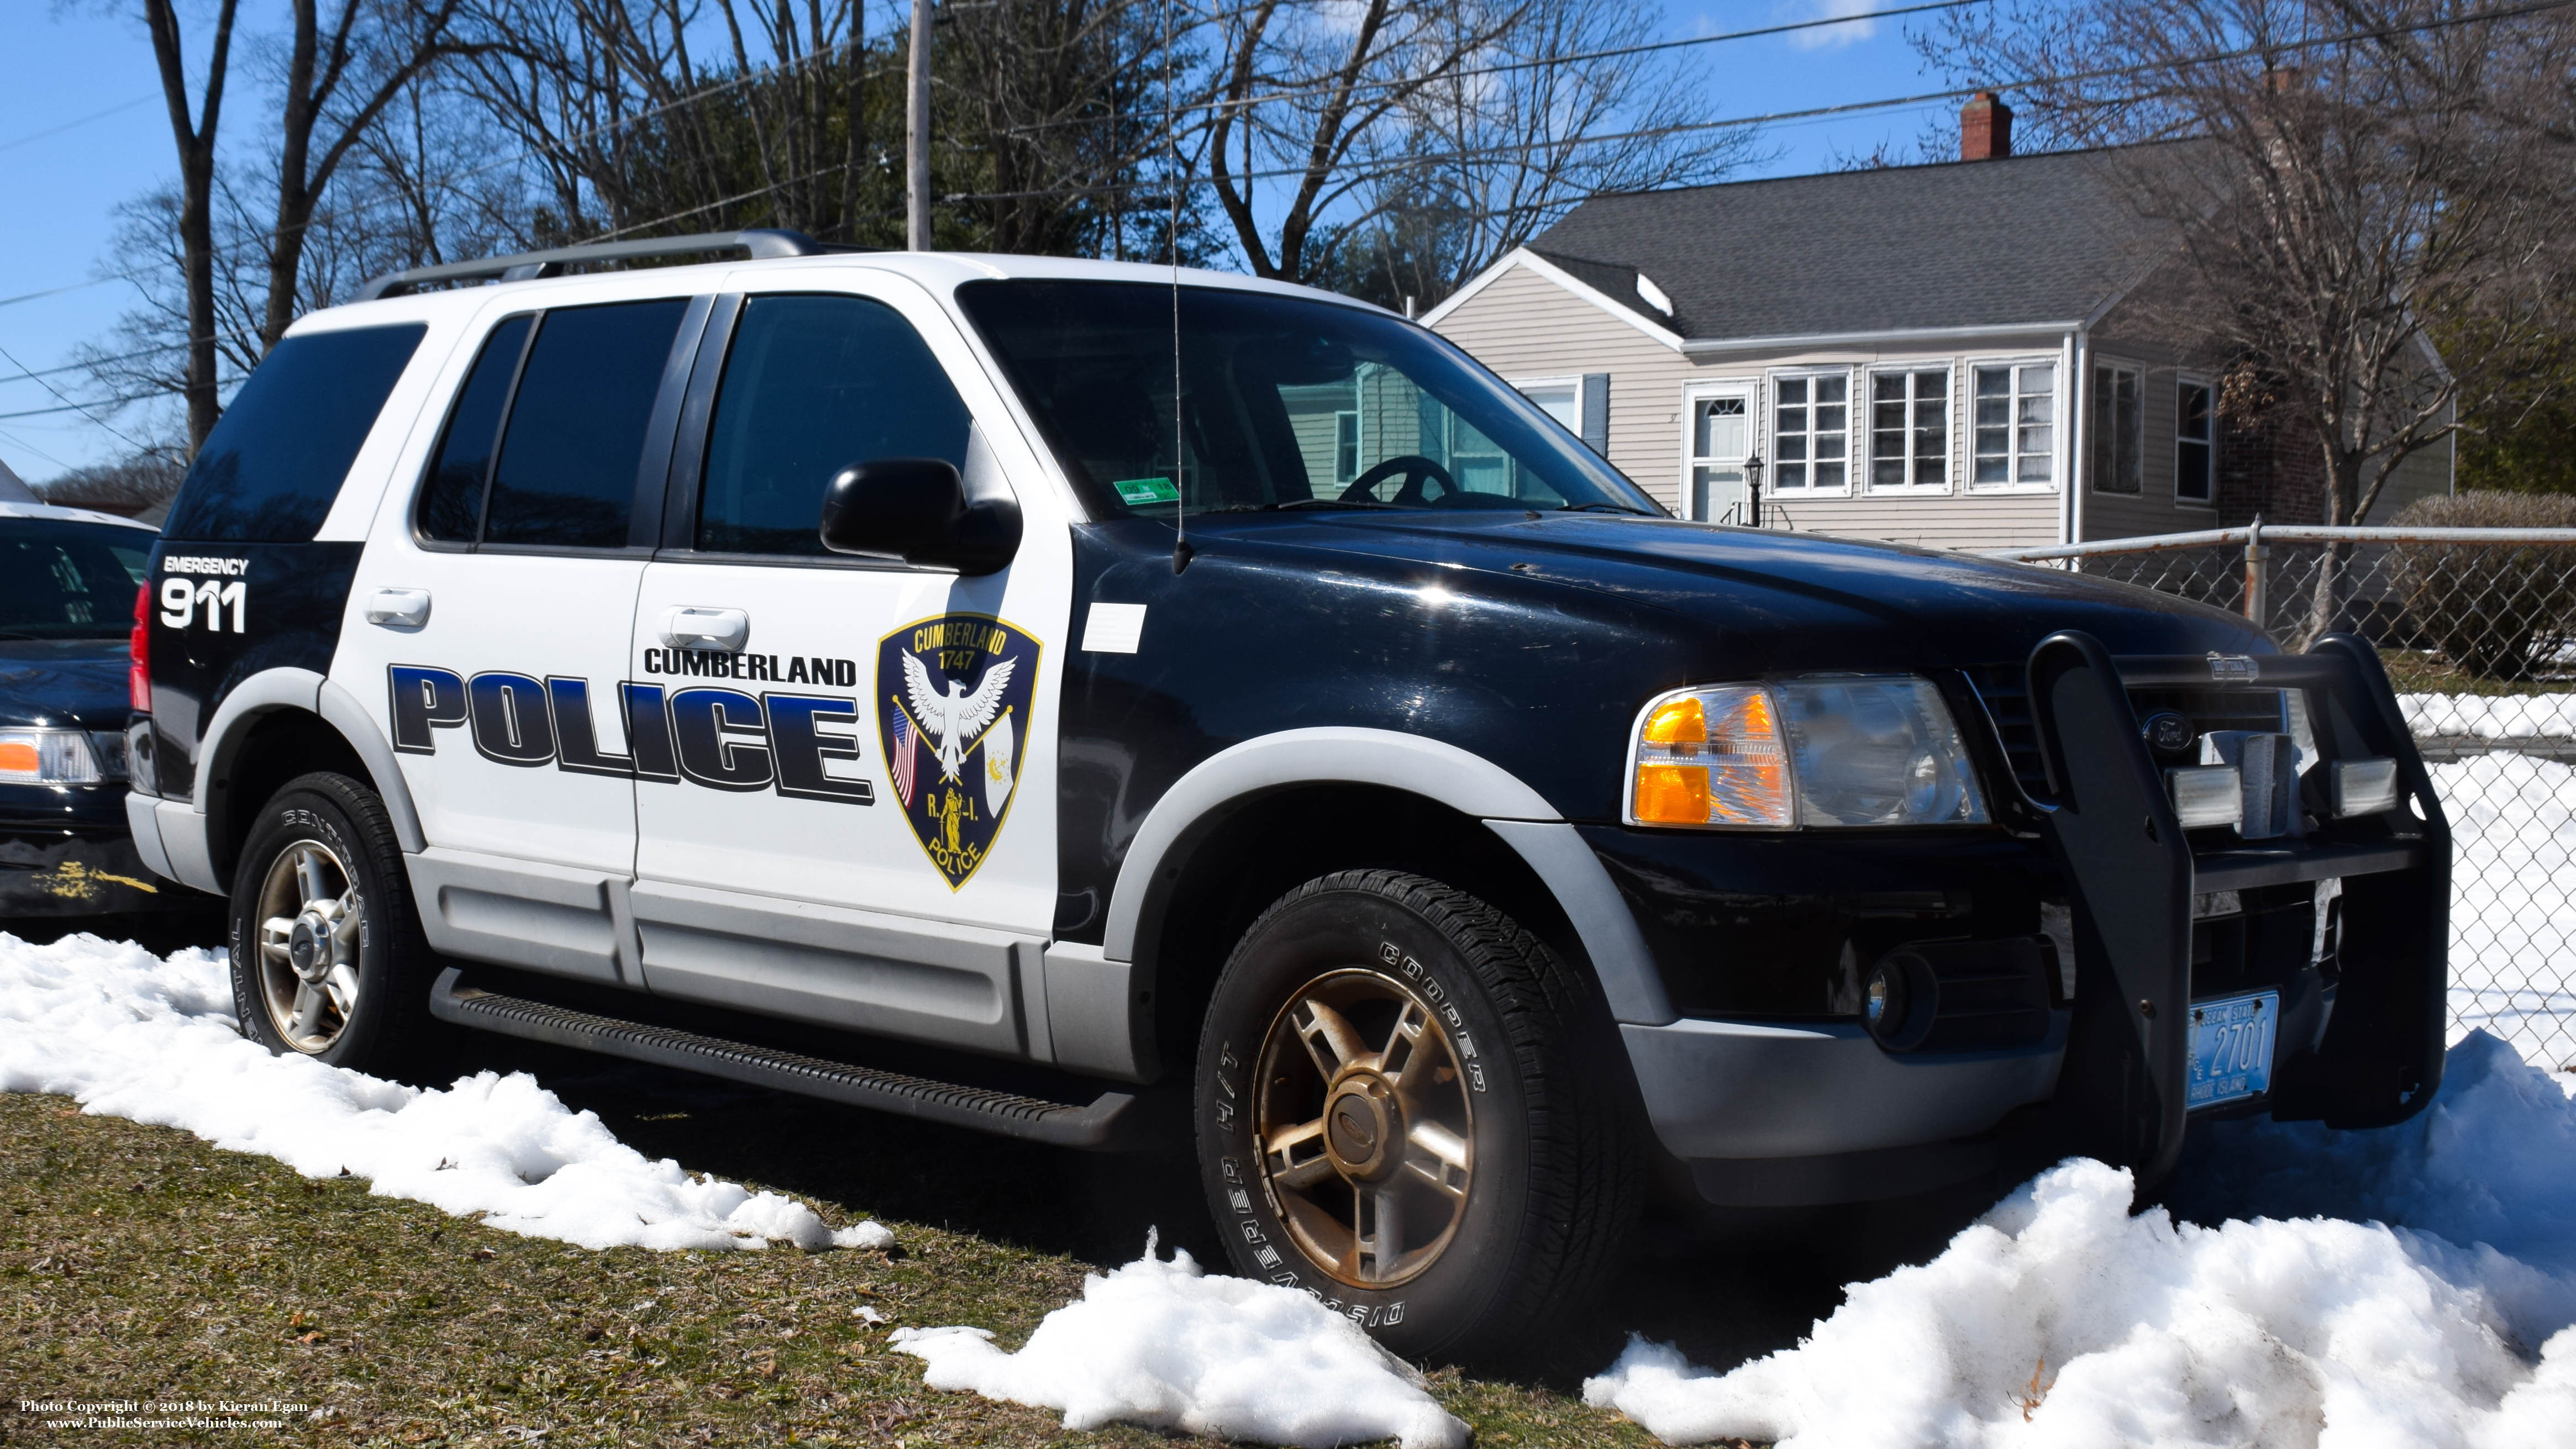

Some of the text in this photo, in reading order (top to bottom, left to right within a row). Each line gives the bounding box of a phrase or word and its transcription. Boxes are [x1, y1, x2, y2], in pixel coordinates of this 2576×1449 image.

[164, 556, 249, 575] EMERGENCY
[161, 578, 246, 633] 911
[914, 623, 1007, 656] CUMBERLAND
[645, 648, 856, 687] CUMBERLAND
[938, 650, 975, 670] 1747
[387, 663, 875, 807] POLICE
[2158, 720, 2183, 742] Ford
[928, 837, 981, 874] POLICE
[1379, 941, 1486, 1092] COOPER
[2211, 1019, 2267, 1077] 2701
